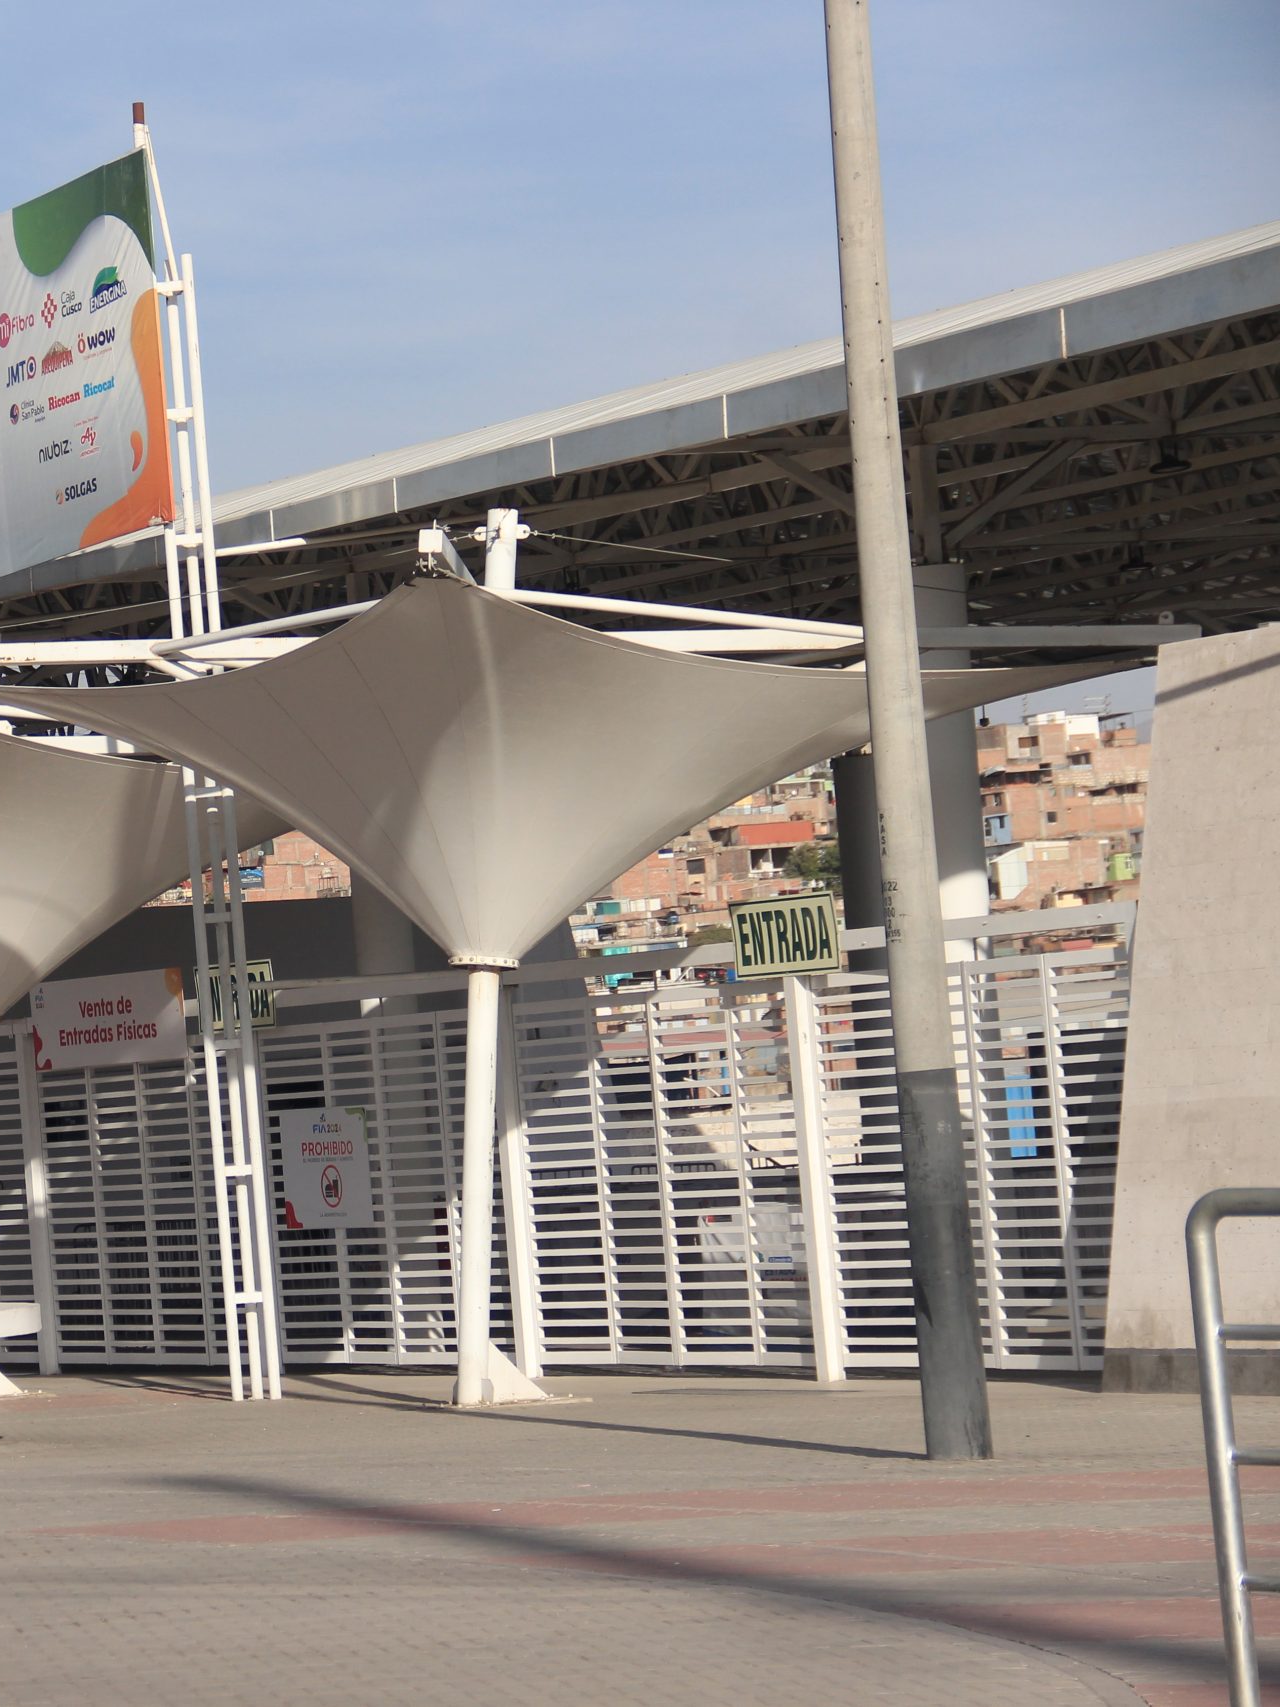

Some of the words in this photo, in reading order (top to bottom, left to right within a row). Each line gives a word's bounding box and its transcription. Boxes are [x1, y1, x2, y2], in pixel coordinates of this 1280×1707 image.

[61, 291, 76, 304] Caja
[89, 280, 127, 313] ENERGINA
[61, 302, 83, 318] Cusco
[48, 391, 81, 411] Ricocan
[83, 376, 115, 398] Ricocat
[30, 404, 45, 417] Pablo
[64, 478, 98, 501] SOLGAS
[736, 905, 833, 967] ENTRADA
[78, 998, 114, 1018] Venta
[116, 995, 133, 1015] de
[58, 1024, 114, 1047] Entradas
[116, 1019, 158, 1041] Físicas
[312, 1124, 326, 1134] FIA
[301, 1141, 354, 1157] PROHIBIDO
